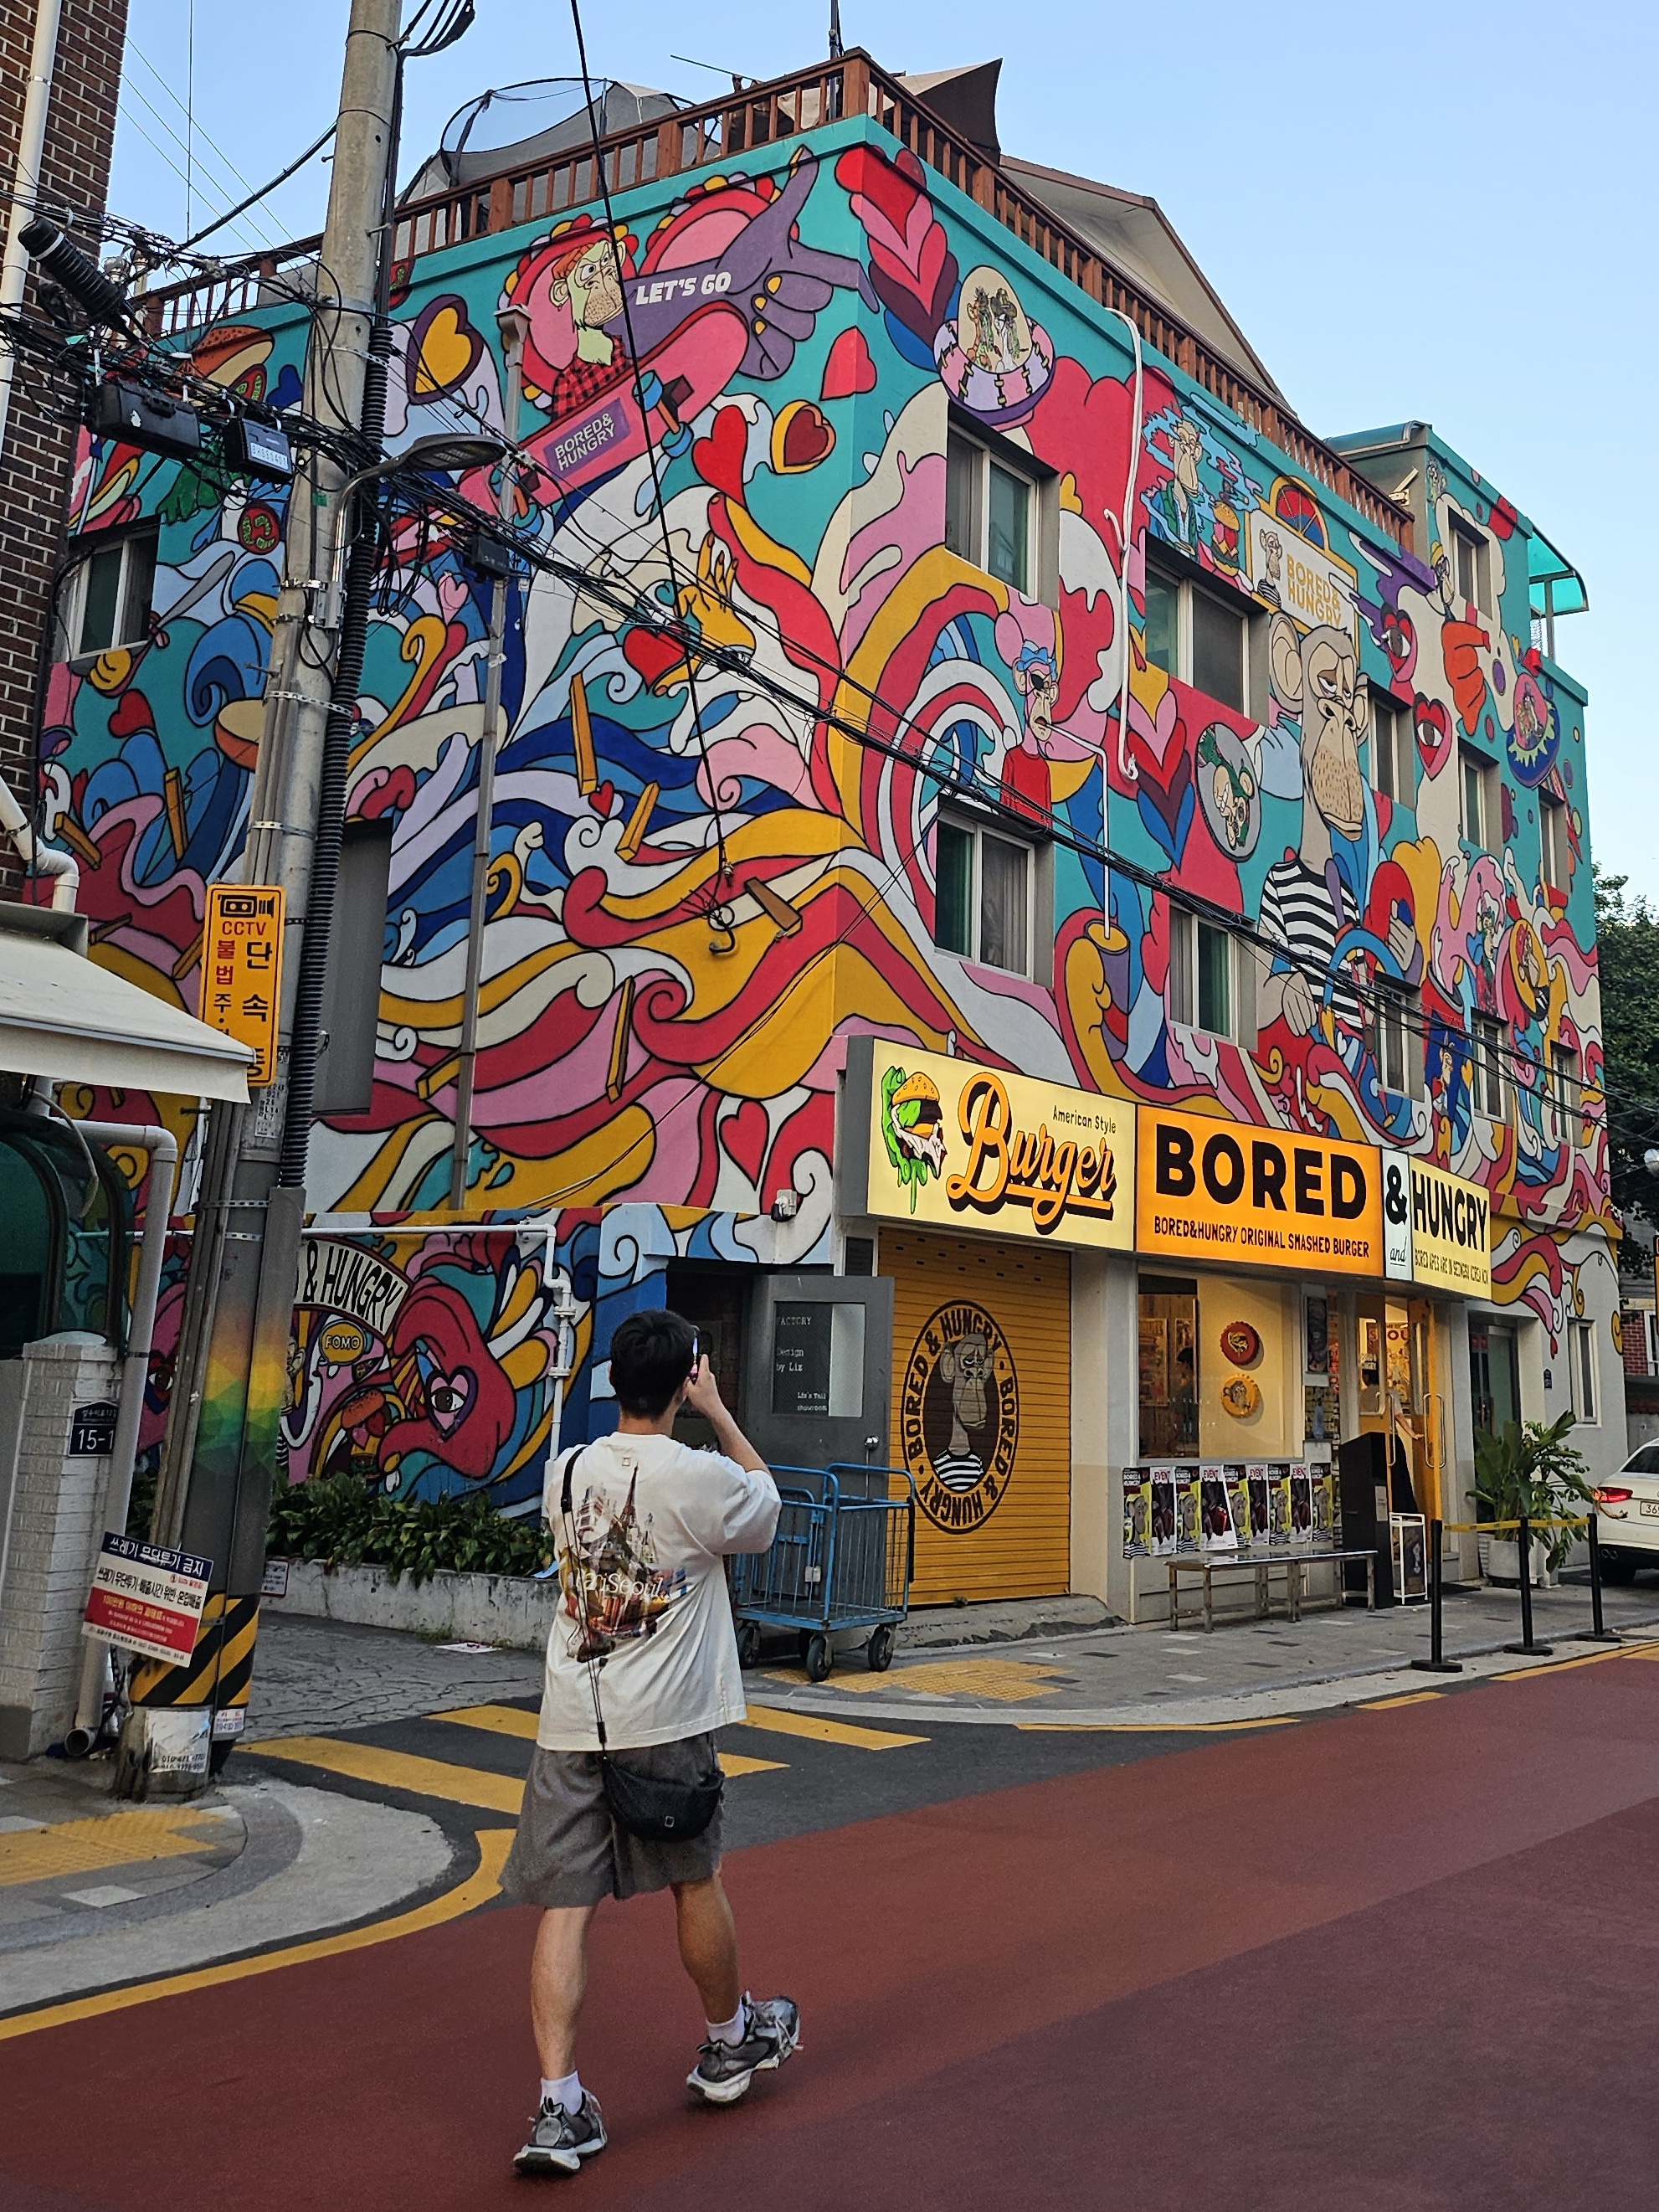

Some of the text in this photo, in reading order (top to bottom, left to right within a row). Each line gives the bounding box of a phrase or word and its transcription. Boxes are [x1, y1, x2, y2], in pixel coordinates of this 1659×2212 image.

[635, 272, 732, 305] LET'S GO
[557, 423, 614, 471] HUNGRY
[1287, 578, 1342, 628] HUNGRY
[222, 921, 267, 935] CCTV
[1053, 1105, 1117, 1134] American Style
[946, 1072, 1117, 1235] Burger
[1156, 1124, 1487, 1253] BORED & HUNGRY
[1154, 1216, 1369, 1258] BORED&HUNGRY ORIGINAL SMASHED BURGER
[1390, 1236, 1407, 1263] and
[321, 1246, 403, 1331] HUNGRY
[325, 1335, 361, 1350] FOMO
[777, 1347, 804, 1358] Design
[776, 1361, 803, 1372] by Liz
[905, 1355, 929, 1461] BORED
[995, 1376, 1015, 1476] BORED
[78, 1428, 114, 1450] 15-1
[920, 1476, 984, 1526] HUNGRY
[1646, 1504, 1659, 1514] 36
[109, 1537, 140, 1557] 쓰레기
[182, 1557, 204, 1577] 금지
